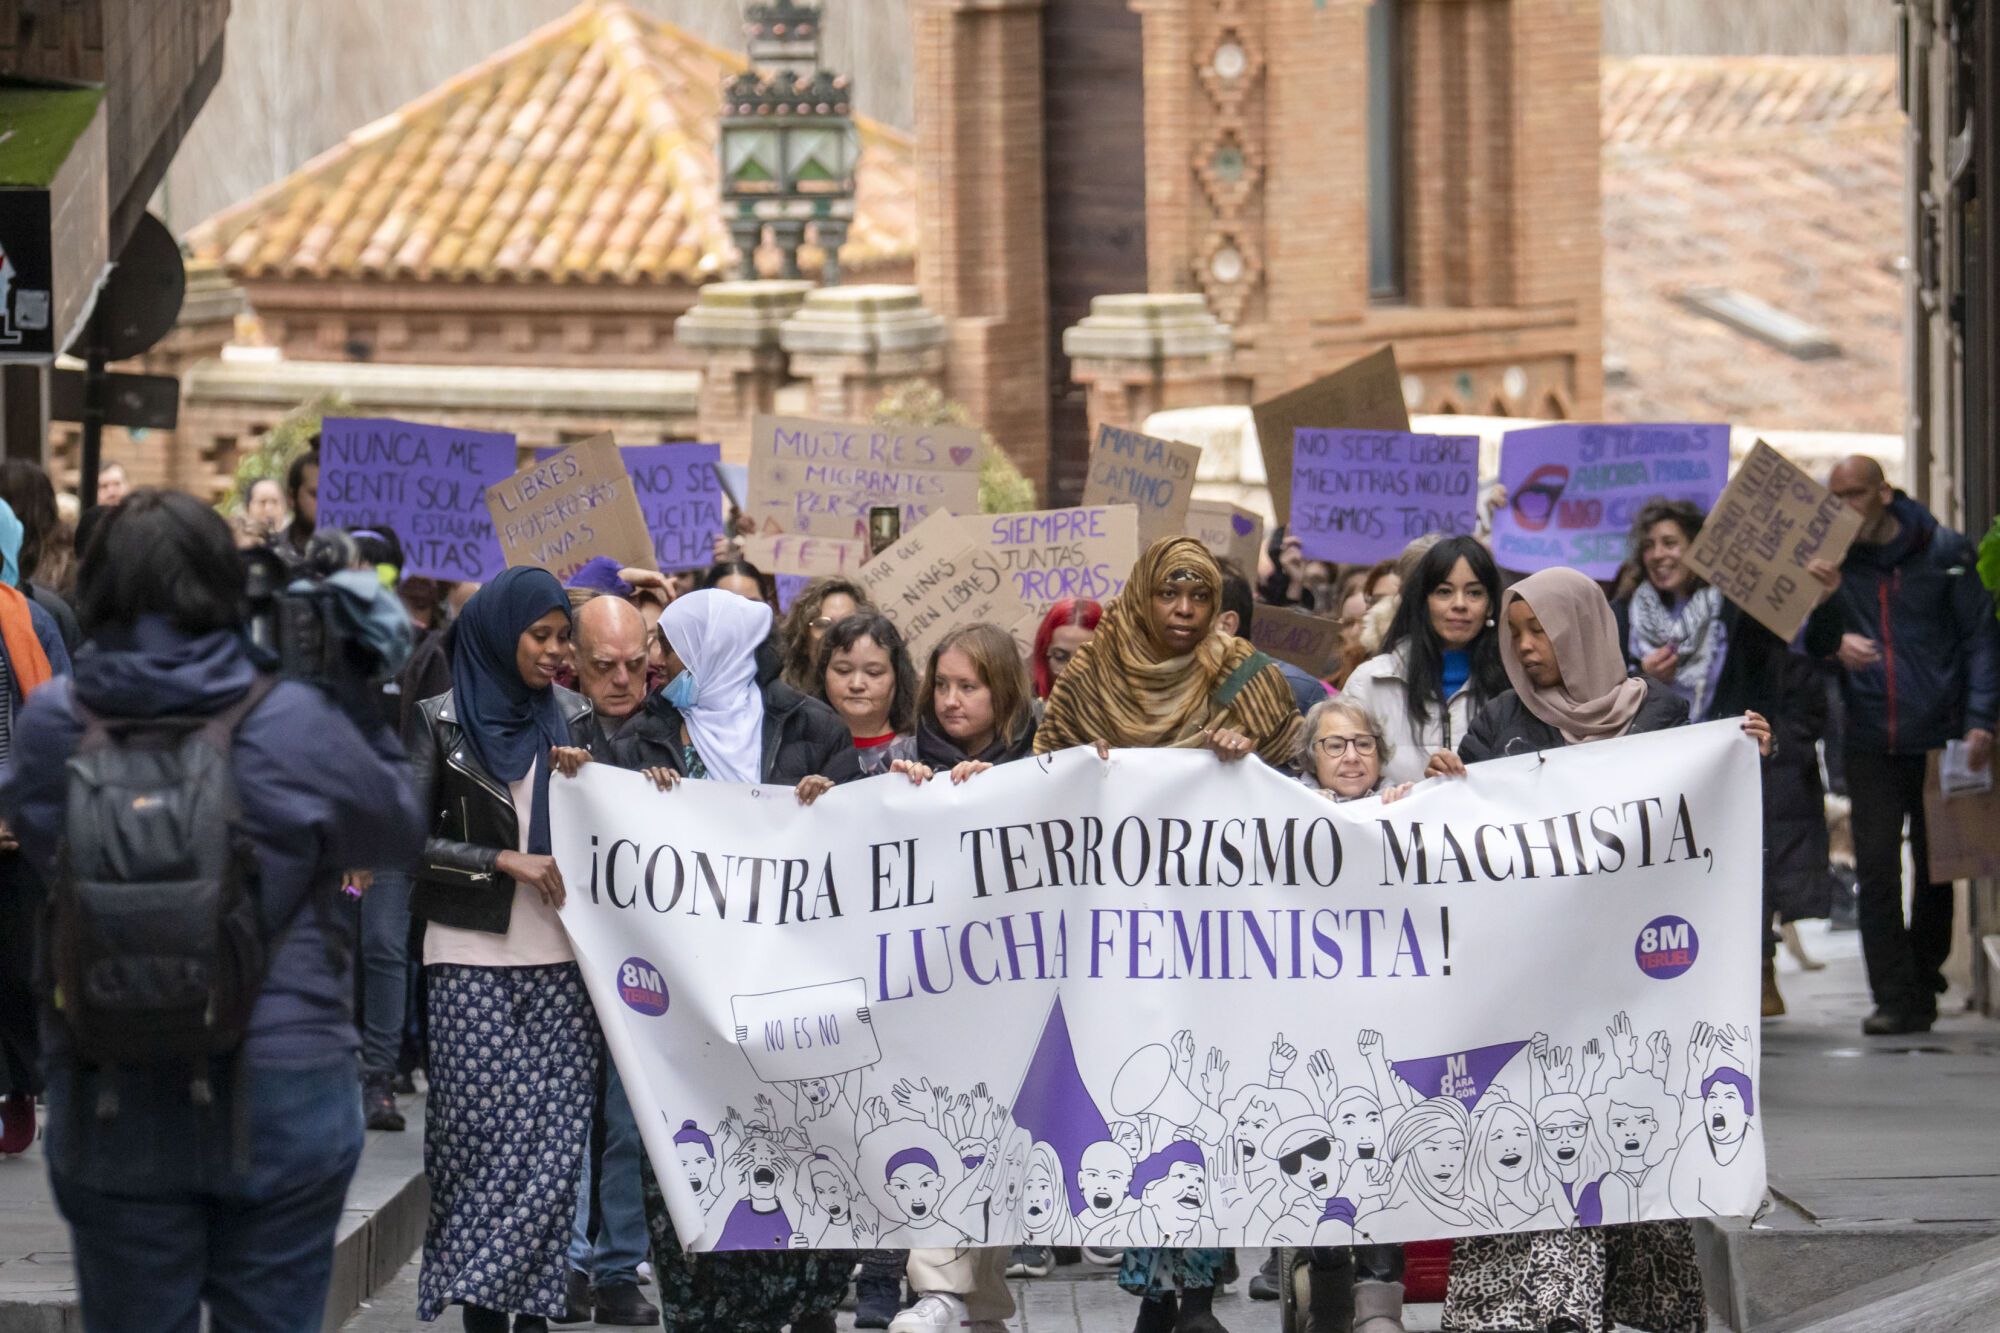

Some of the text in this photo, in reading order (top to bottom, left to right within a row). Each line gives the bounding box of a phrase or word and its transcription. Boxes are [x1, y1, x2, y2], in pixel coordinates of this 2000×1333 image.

[326, 431, 483, 475] NUNCA ME
[773, 427, 936, 464] MUJERES
[1300, 433, 1329, 457] NO
[1409, 438, 1471, 465] LIBRE
[416, 474, 487, 512] SOLA
[805, 465, 944, 495] MIGRANTES
[1093, 461, 1174, 508] CAMINO
[1295, 467, 1410, 497] MIENTRAS
[504, 480, 615, 549] PODEROSAS
[992, 510, 1106, 545] SIEMPRE
[1296, 504, 1471, 539] SEAMOS TODAS
[1557, 499, 1603, 528] NO
[864, 561, 895, 589] ARA
[1765, 574, 1796, 611] NO
[590, 793, 1715, 927] ¡CONTRA EL TERRORISMO MACHISTA,
[875, 905, 1452, 1003] LUCHA FEMINISTA!
[1641, 923, 1689, 953] 8M
[1639, 949, 1692, 970] TERUEL
[622, 963, 662, 993] 8M
[765, 1014, 840, 1052] NO ES NO
